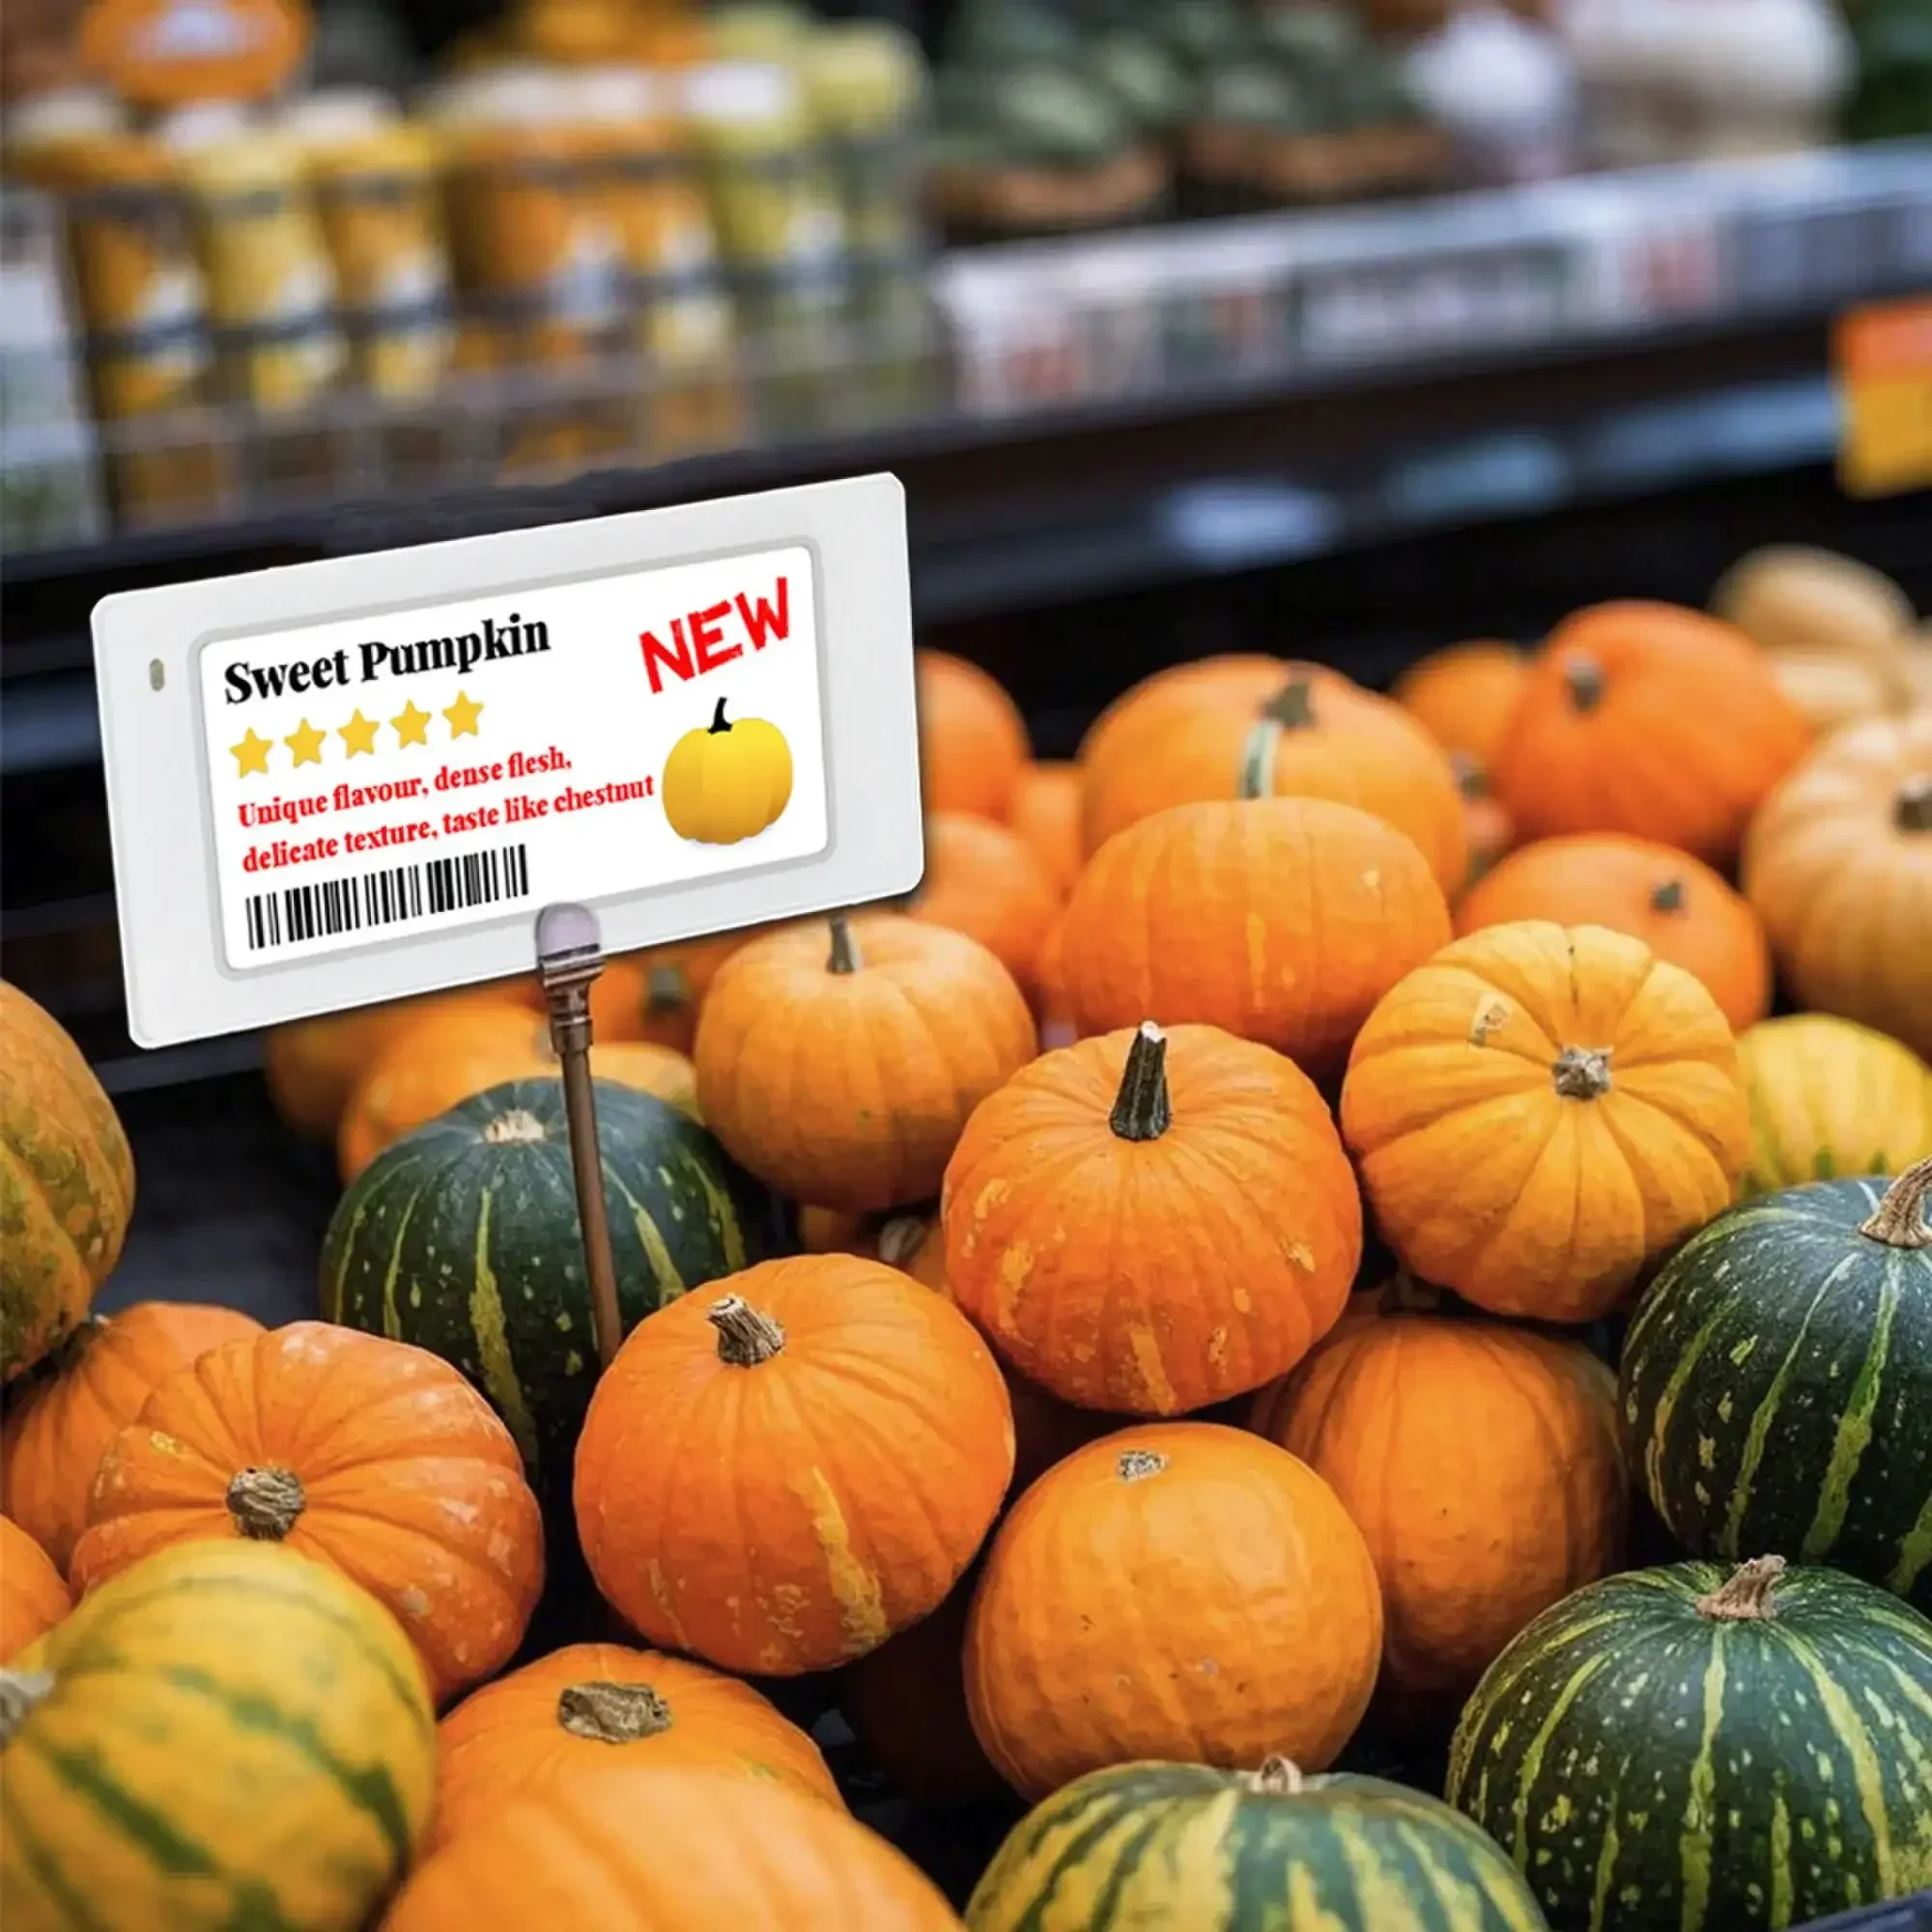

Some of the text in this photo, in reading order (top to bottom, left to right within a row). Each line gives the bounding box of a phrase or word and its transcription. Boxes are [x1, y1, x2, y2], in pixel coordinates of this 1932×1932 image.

[225, 613, 551, 704] Sweet Pumpkin
[639, 577, 789, 695] NEW
[238, 746, 572, 828] Unique flavour, dense flesh,
[242, 776, 654, 873] delicate texture, taste like chestnut
